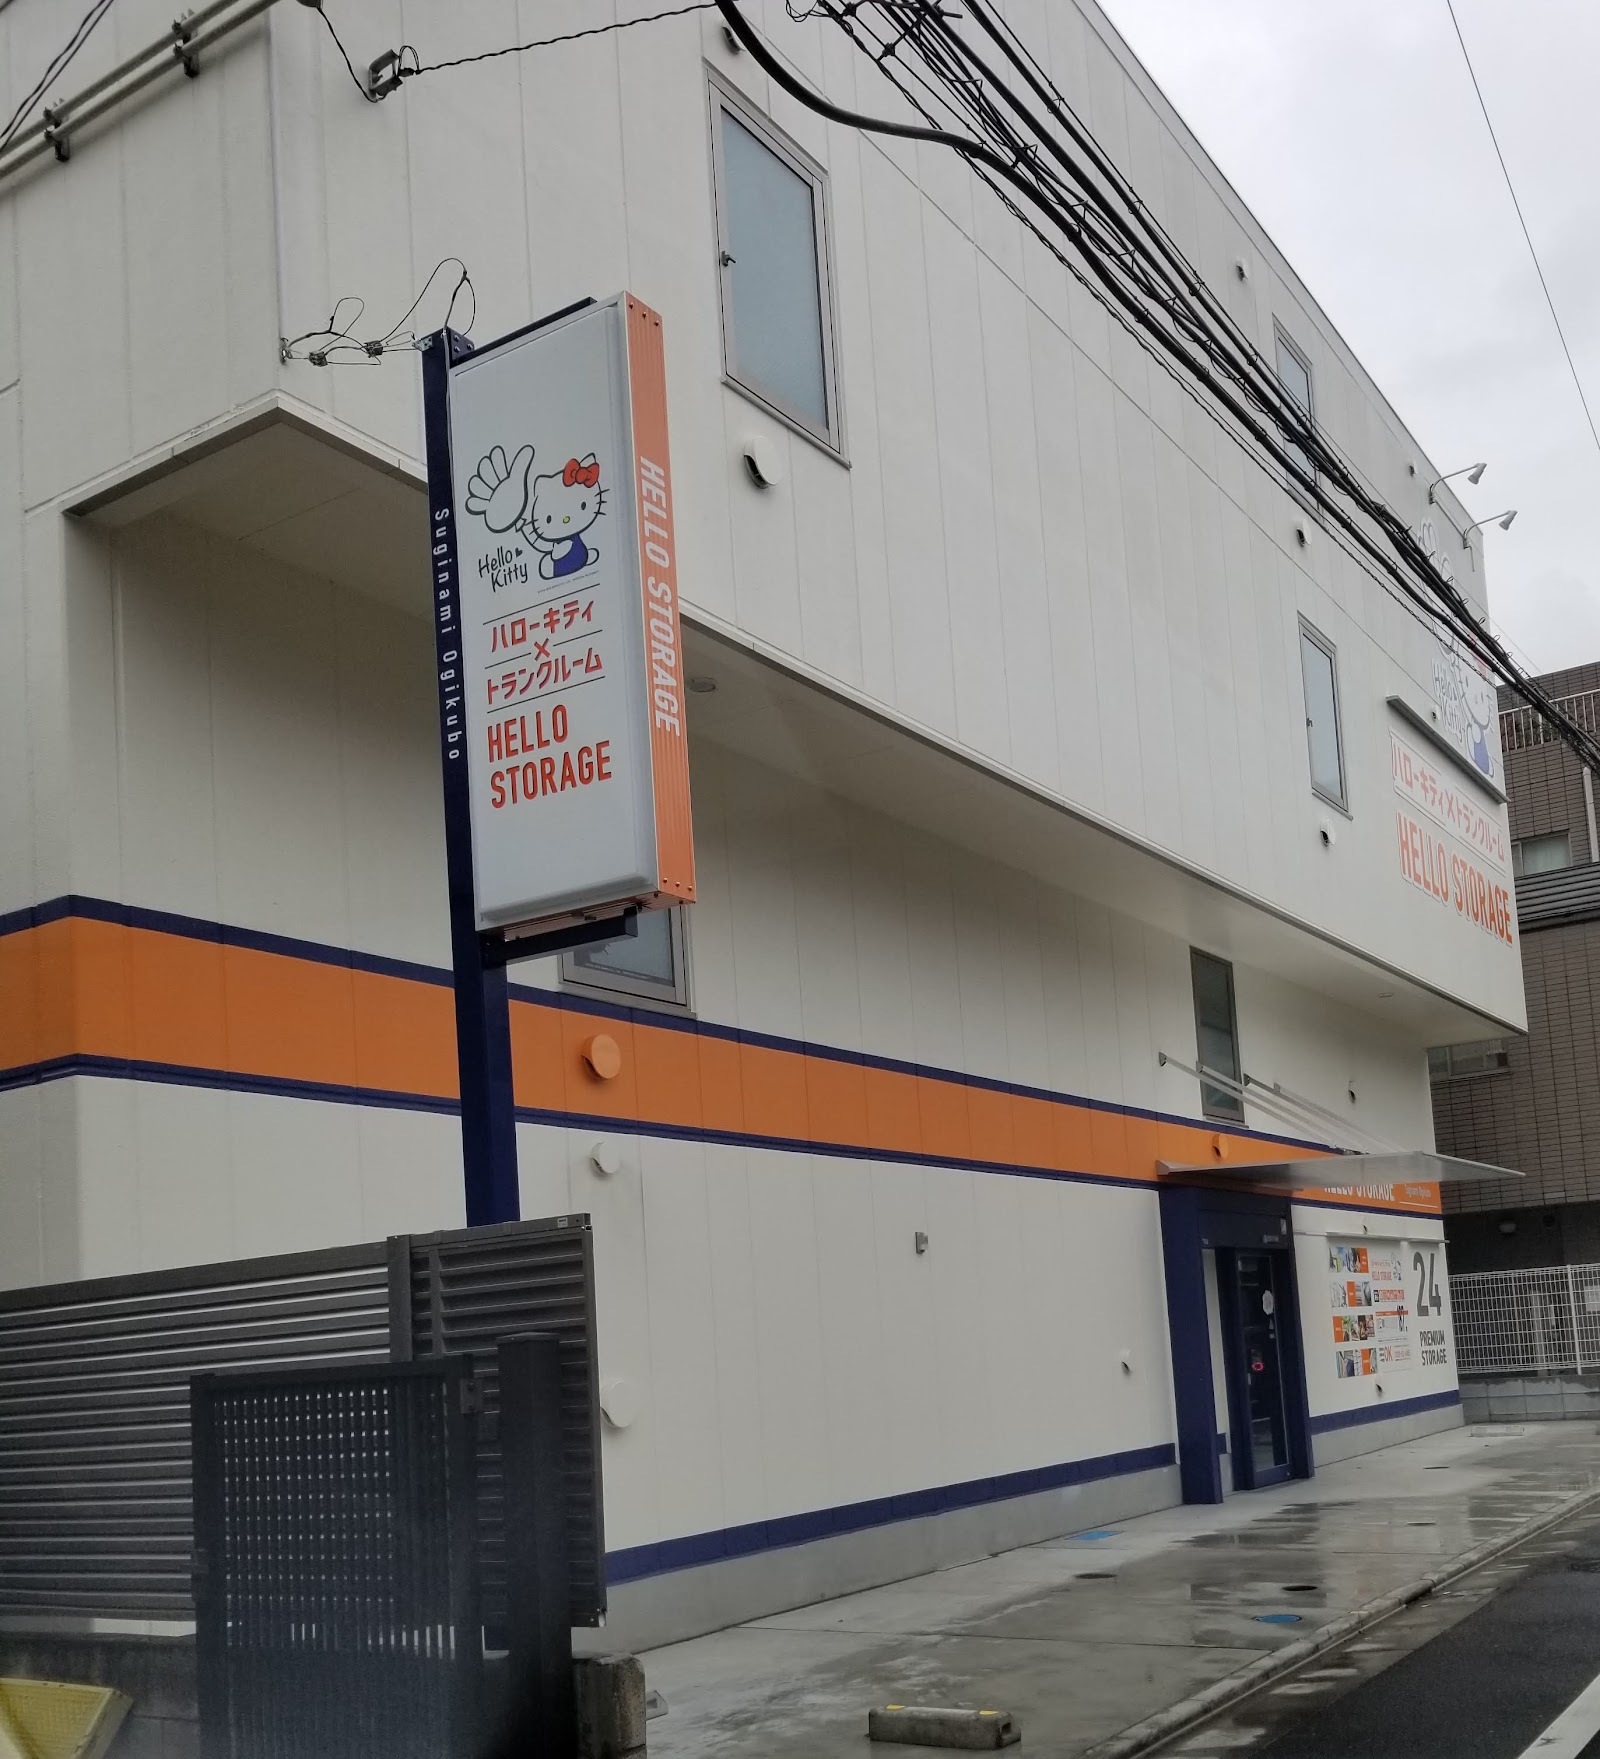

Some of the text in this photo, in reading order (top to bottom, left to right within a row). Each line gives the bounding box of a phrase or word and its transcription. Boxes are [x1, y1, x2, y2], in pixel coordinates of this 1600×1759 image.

[478, 546, 513, 579] Hello
[491, 559, 528, 592] Kitty
[640, 456, 681, 738] HELLO STORAGE
[432, 508, 462, 760] Suginami Ogikubo
[490, 600, 594, 653] ハローキティ
[486, 647, 603, 704] トランクルーム
[487, 704, 568, 763] HELLO
[490, 740, 612, 809] STORAGE
[1397, 811, 1512, 944] HELLO STORAGE
[1413, 1252, 1441, 1316] 24
[1419, 1330, 1446, 1347] PREMIUM
[1421, 1348, 1447, 1366] STORAGE
